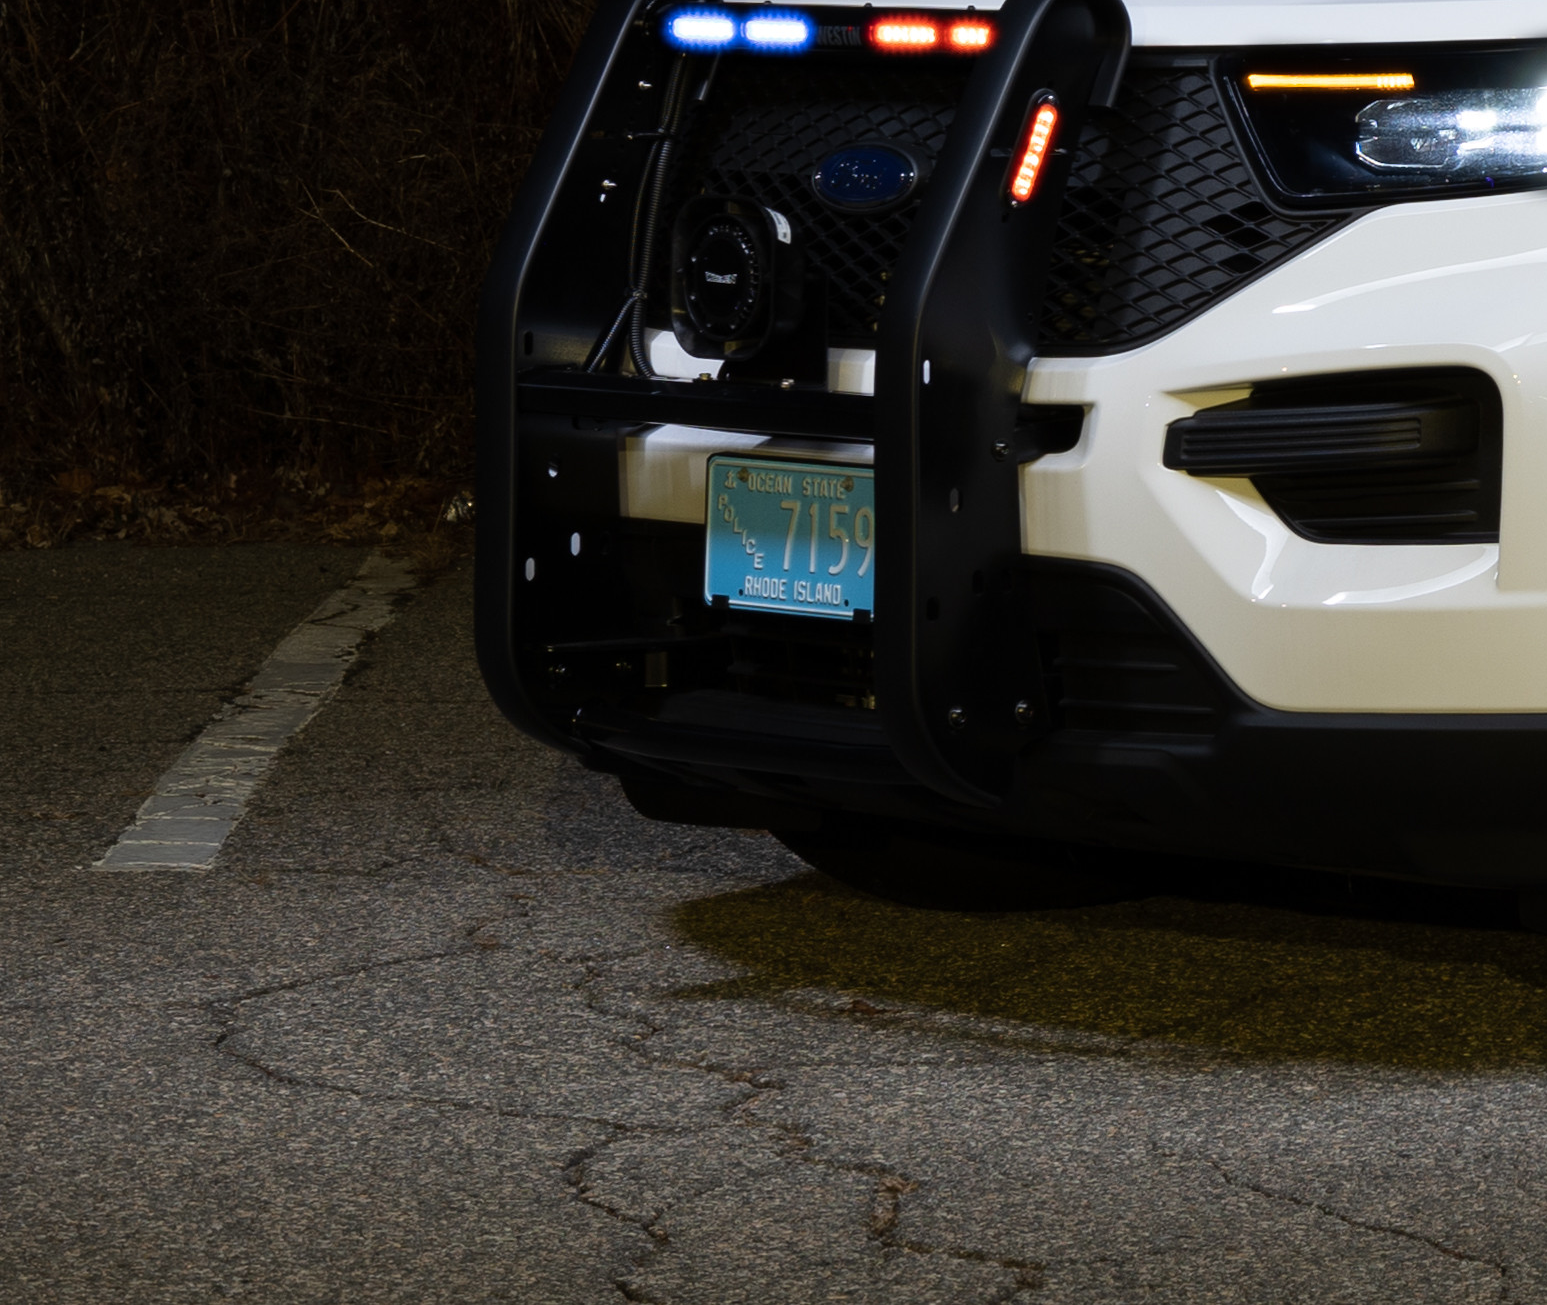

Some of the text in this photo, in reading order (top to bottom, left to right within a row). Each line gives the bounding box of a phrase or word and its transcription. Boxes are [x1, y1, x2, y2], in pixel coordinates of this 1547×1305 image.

[748, 472, 847, 500] OCEAN STATE
[718, 494, 765, 570] POLICE
[780, 500, 874, 577] 7159
[744, 575, 842, 605] RHODE ISLAND
